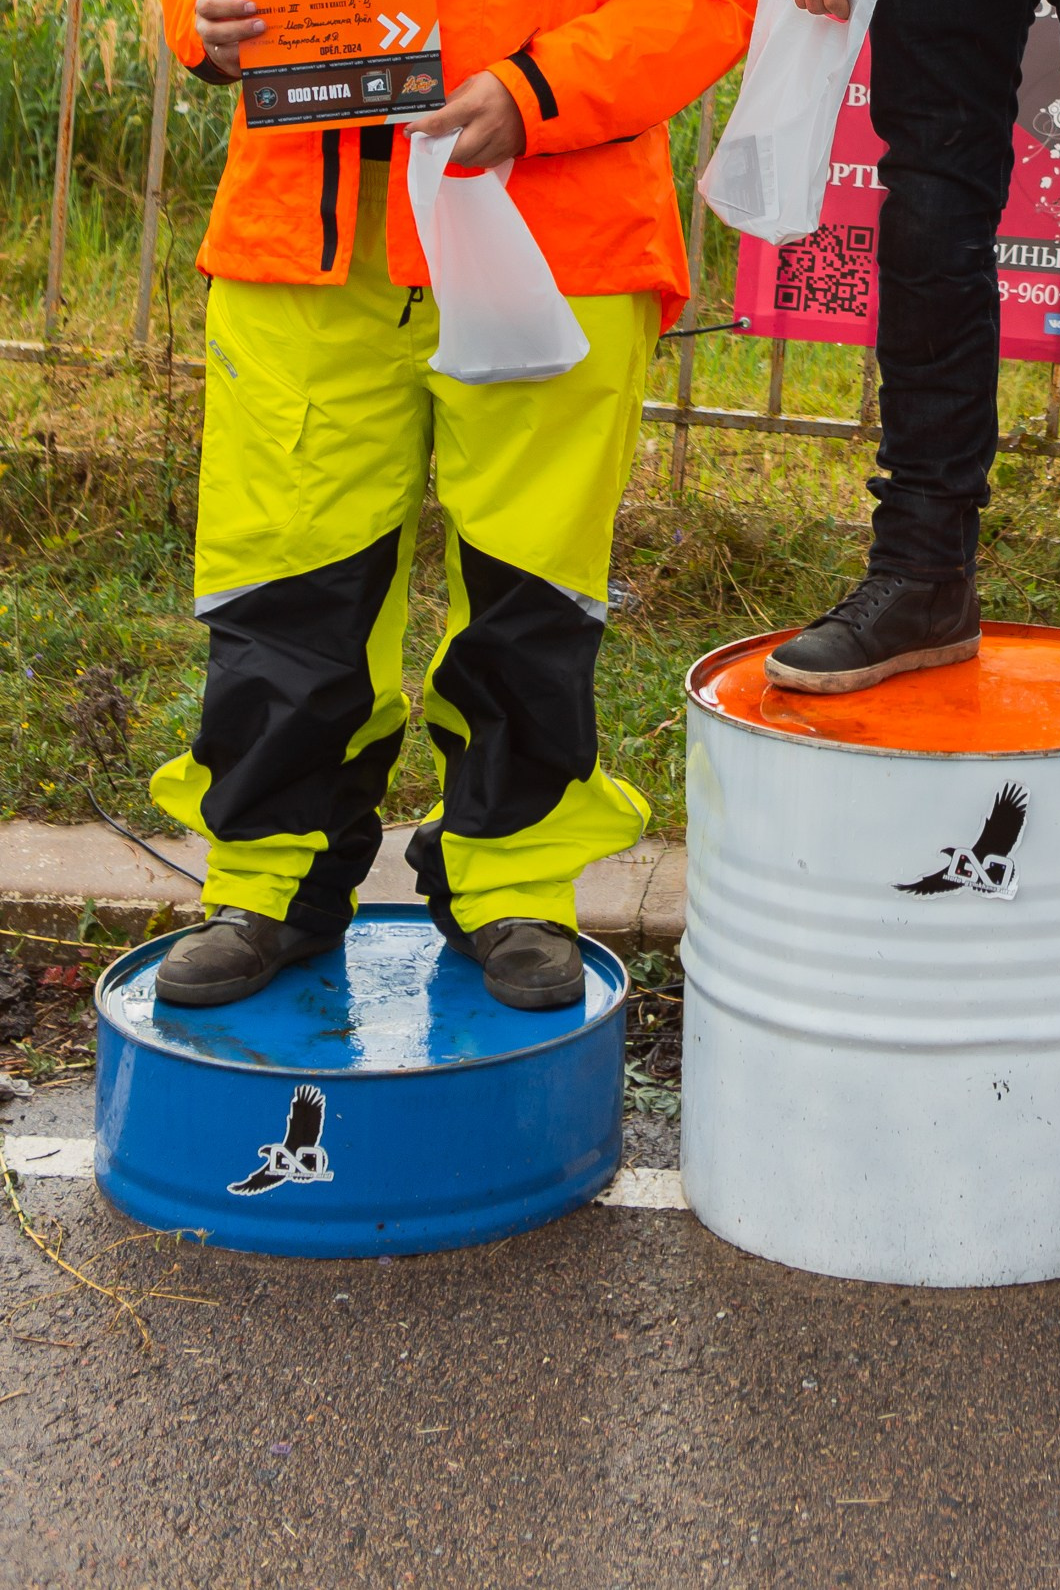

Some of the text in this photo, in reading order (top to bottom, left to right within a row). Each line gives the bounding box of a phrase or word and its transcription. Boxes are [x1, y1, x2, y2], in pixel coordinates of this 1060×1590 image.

[319, 43, 361, 56] ОРЁЛ, 2024
[287, 87, 311, 103] ООО
[312, 85, 328, 101] ТД
[328, 83, 351, 99] ИТА
